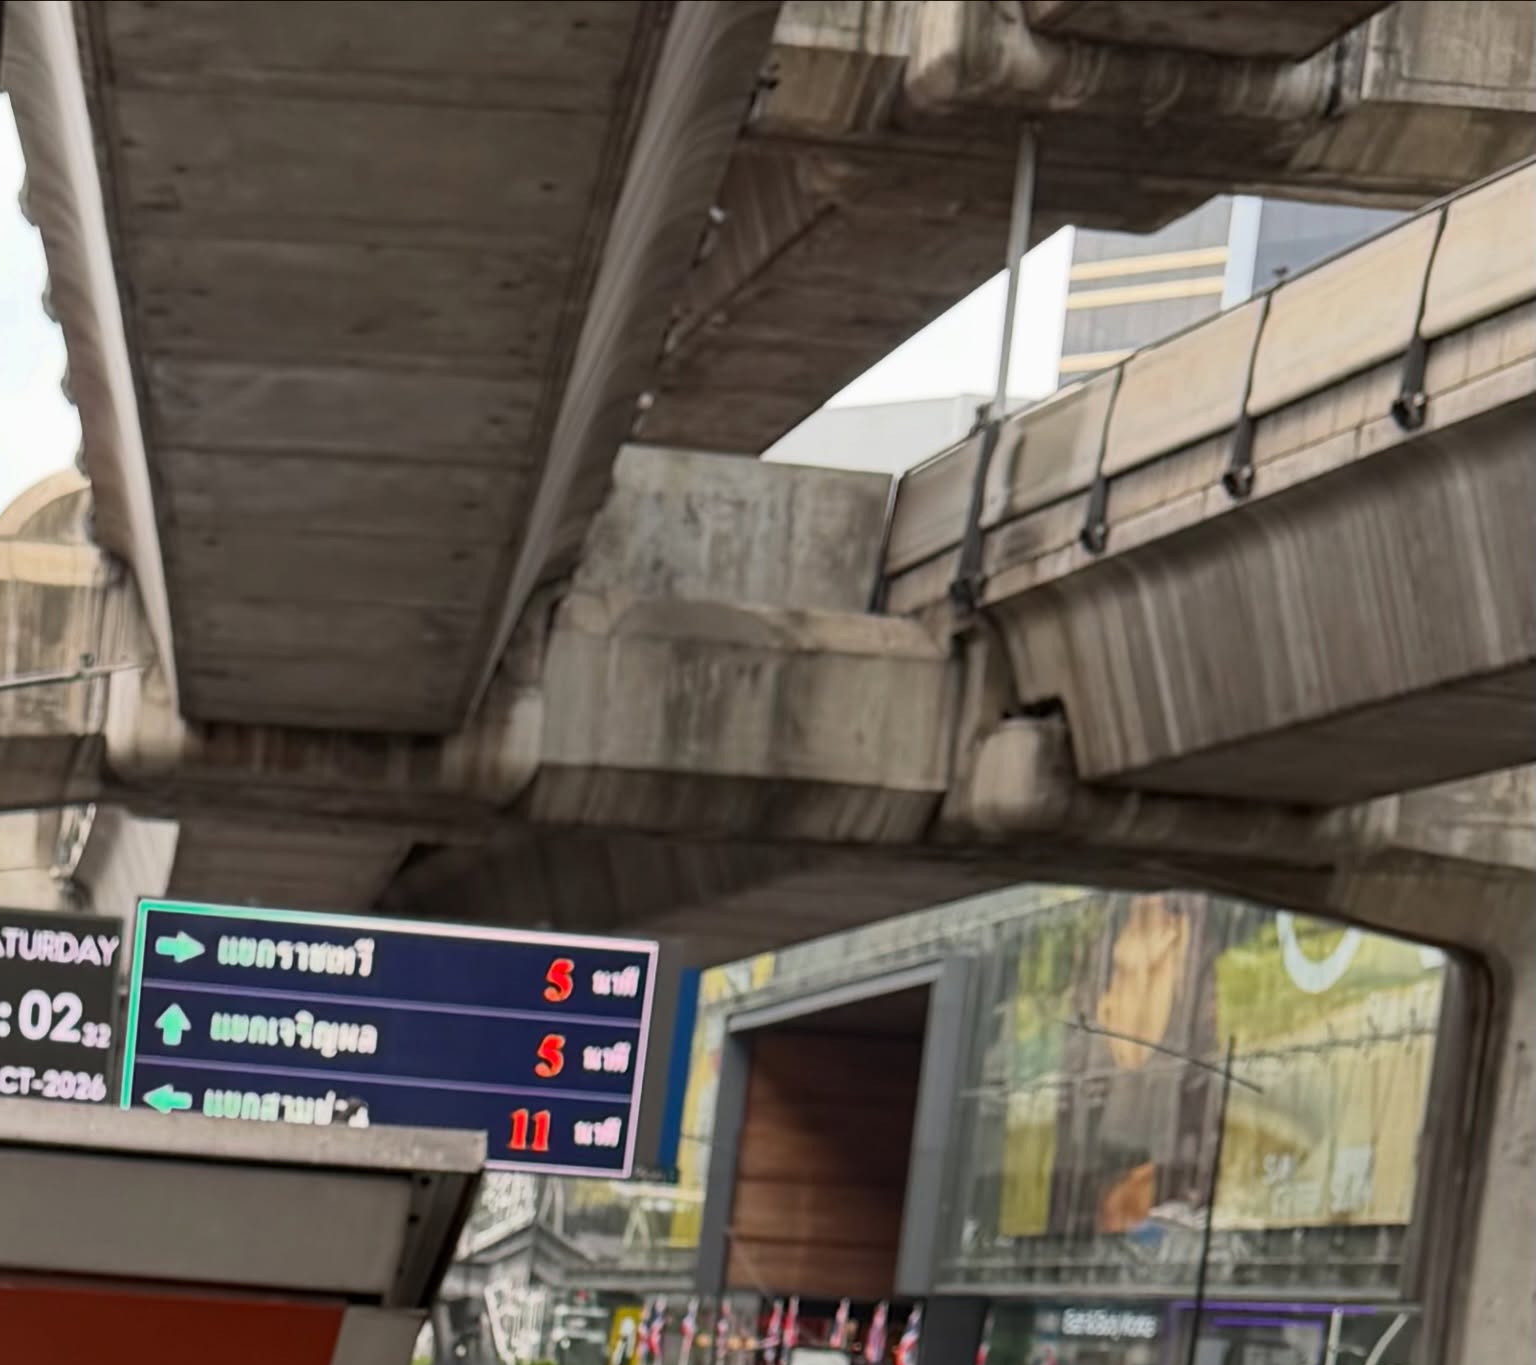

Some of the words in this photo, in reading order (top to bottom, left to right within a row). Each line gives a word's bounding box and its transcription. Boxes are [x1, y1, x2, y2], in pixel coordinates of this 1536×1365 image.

[544, 958, 575, 1002] 5
[534, 1033, 565, 1078] 5
[507, 1108, 551, 1152] 11
